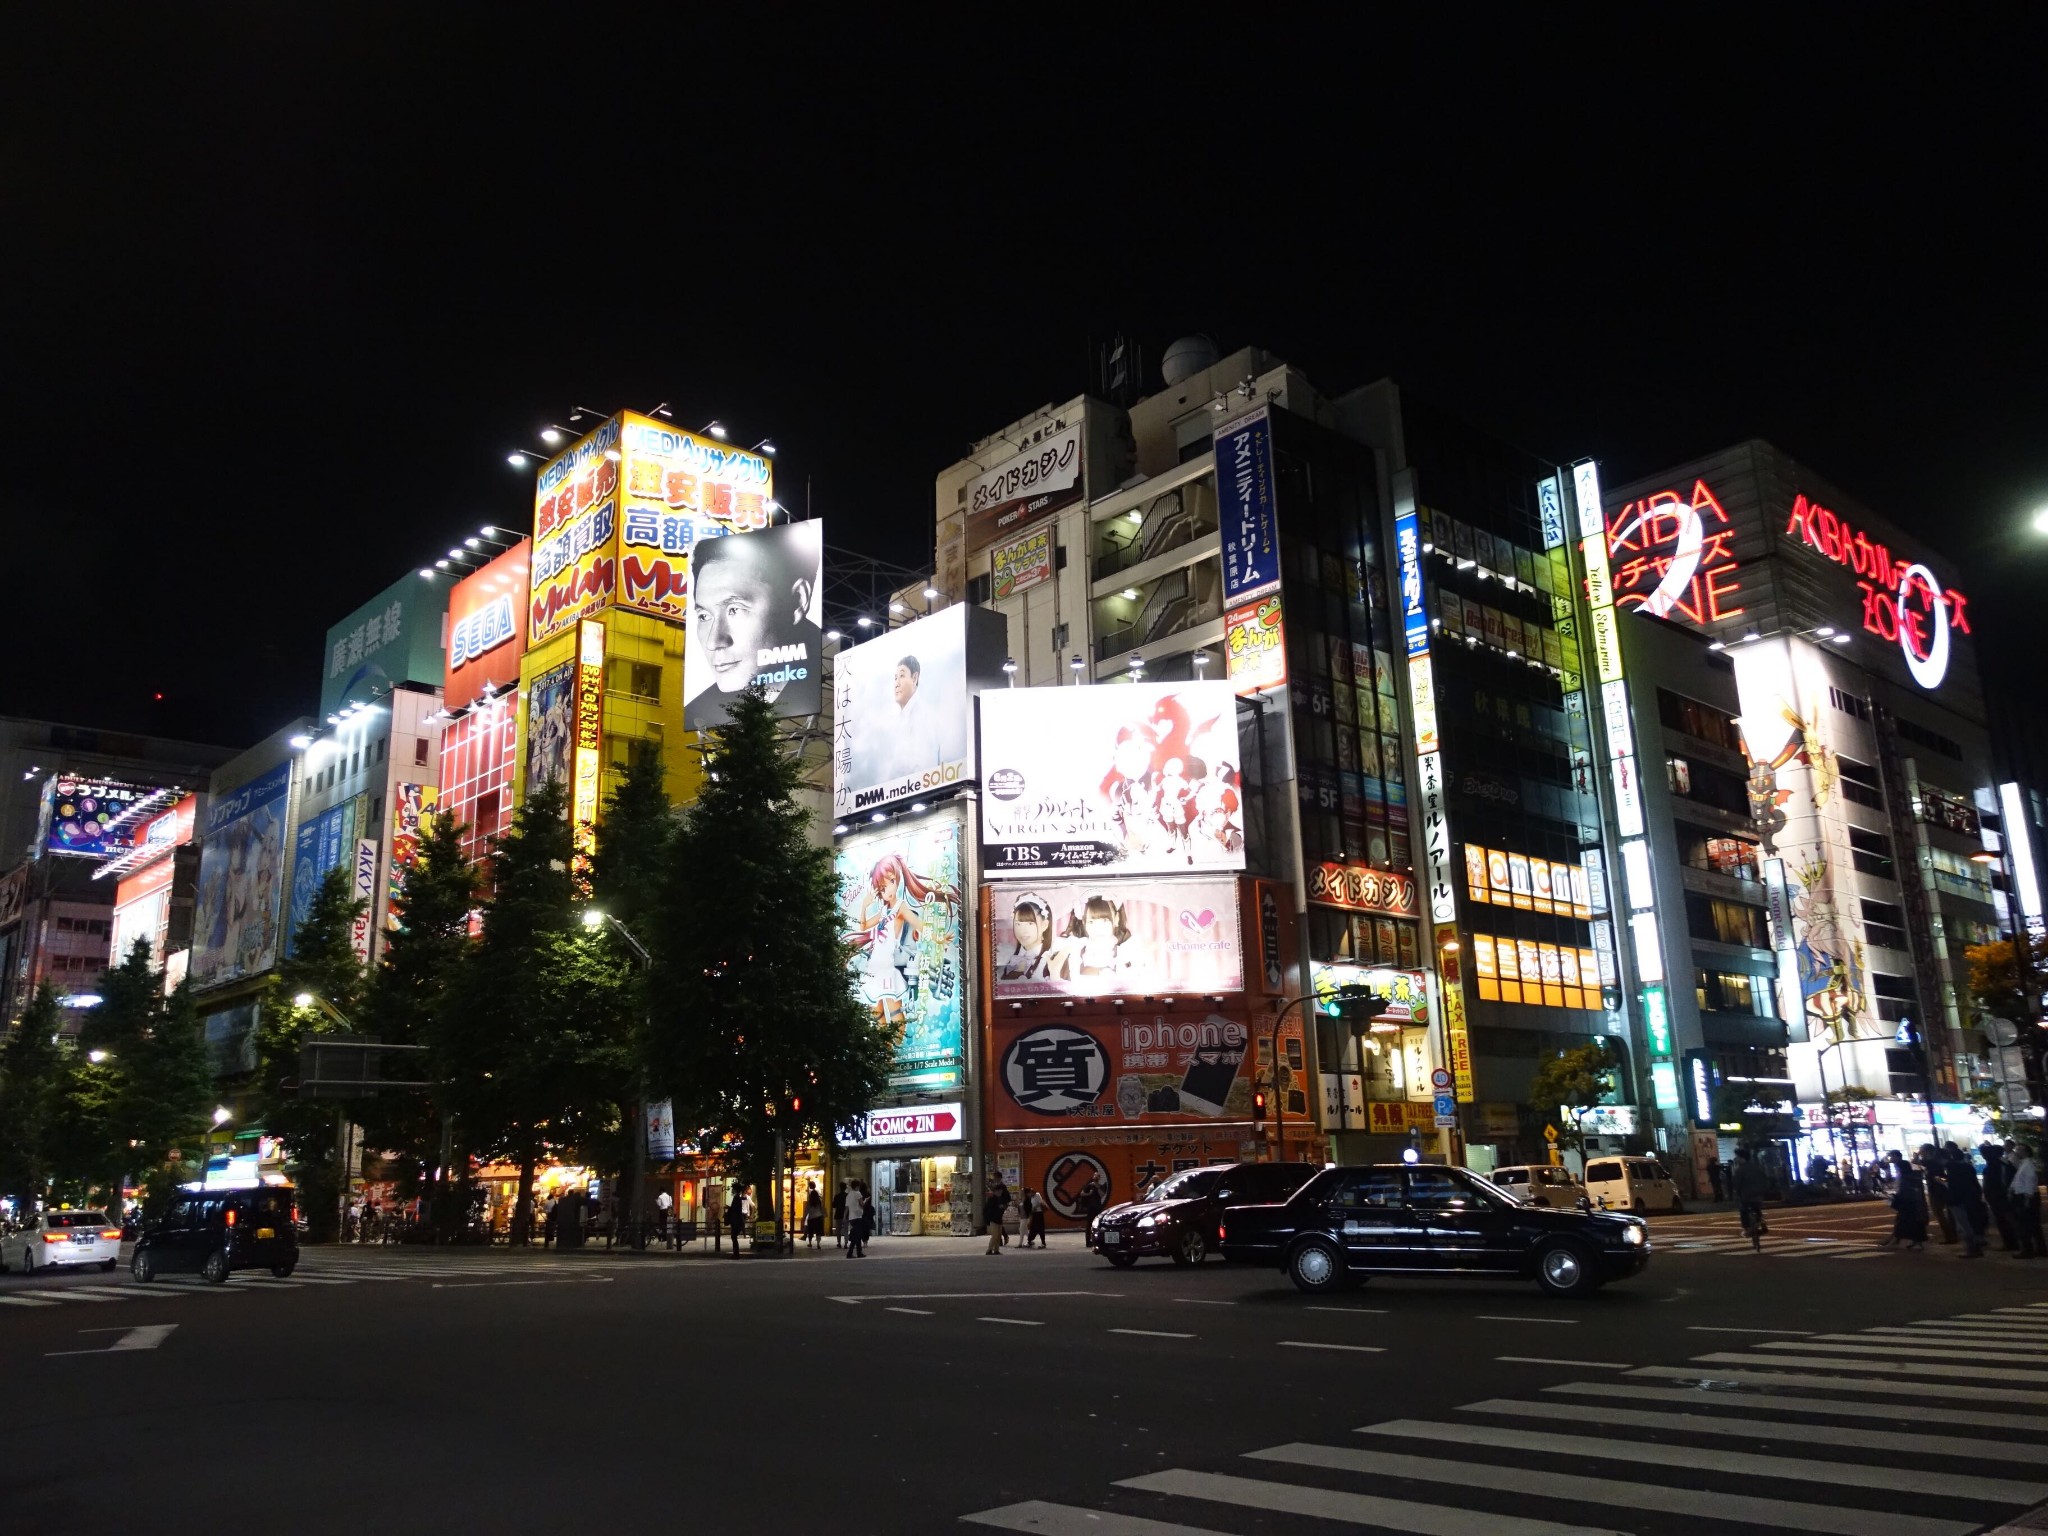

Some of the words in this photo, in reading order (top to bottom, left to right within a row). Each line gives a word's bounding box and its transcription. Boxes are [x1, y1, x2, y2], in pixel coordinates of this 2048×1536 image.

[1218, 421, 1241, 436] AMENITY
[1244, 410, 1264, 424] DREAM
[973, 440, 1075, 511] メイドカジノ
[538, 459, 617, 538] 激安販売
[630, 458, 766, 527] 激安販売
[998, 511, 1018, 527] POKER
[1028, 496, 1049, 512] STARS
[1233, 431, 1260, 584] アメニティードリーム
[1604, 479, 1729, 558] KIBA
[626, 508, 735, 551] 高額
[534, 500, 615, 588] 高額買取
[994, 531, 1048, 570] まんが喫茶
[1228, 542, 1239, 589] 秋葉原店
[1229, 592, 1253, 607] AMENITY
[1256, 584, 1278, 597] DREAM
[1590, 566, 1601, 604] Yellow
[637, 596, 683, 615] ムーラン
[452, 595, 513, 665] SEGA
[1228, 624, 1281, 655] まんが
[757, 643, 808, 667] DMM
[1595, 613, 1613, 675] Submarine
[563, 666, 574, 682] AIR
[583, 665, 600, 676] DVD
[581, 684, 600, 694] ゲーム
[583, 694, 596, 702] CD
[580, 711, 599, 721] アニメ
[1312, 693, 1331, 715] 6F
[922, 761, 963, 789] solar
[1319, 787, 1337, 808] 5F
[989, 817, 1060, 837] VIRGIN
[1066, 821, 1113, 834] SOUL
[1003, 846, 1041, 861] TBS
[1051, 851, 1105, 861] プライム・ビデオ
[1061, 844, 1095, 852] Amazon
[357, 843, 374, 897] AKKY
[1309, 866, 1415, 912] メイドカジノ
[1120, 1015, 1243, 1052] iphone
[914, 1061, 924, 1069] 1/7
[924, 1060, 938, 1069] Scale
[938, 1057, 955, 1067] Model
[1014, 1034, 1100, 1107] 質
[1123, 1052, 1169, 1068] 携帯
[1177, 1050, 1245, 1067] スマホ
[1435, 1073, 1447, 1083] 40
[1438, 1100, 1446, 1114] P
[872, 1116, 914, 1135] COMIC
[916, 1115, 935, 1131] ZIN
[1158, 1142, 1213, 1156] チケット
